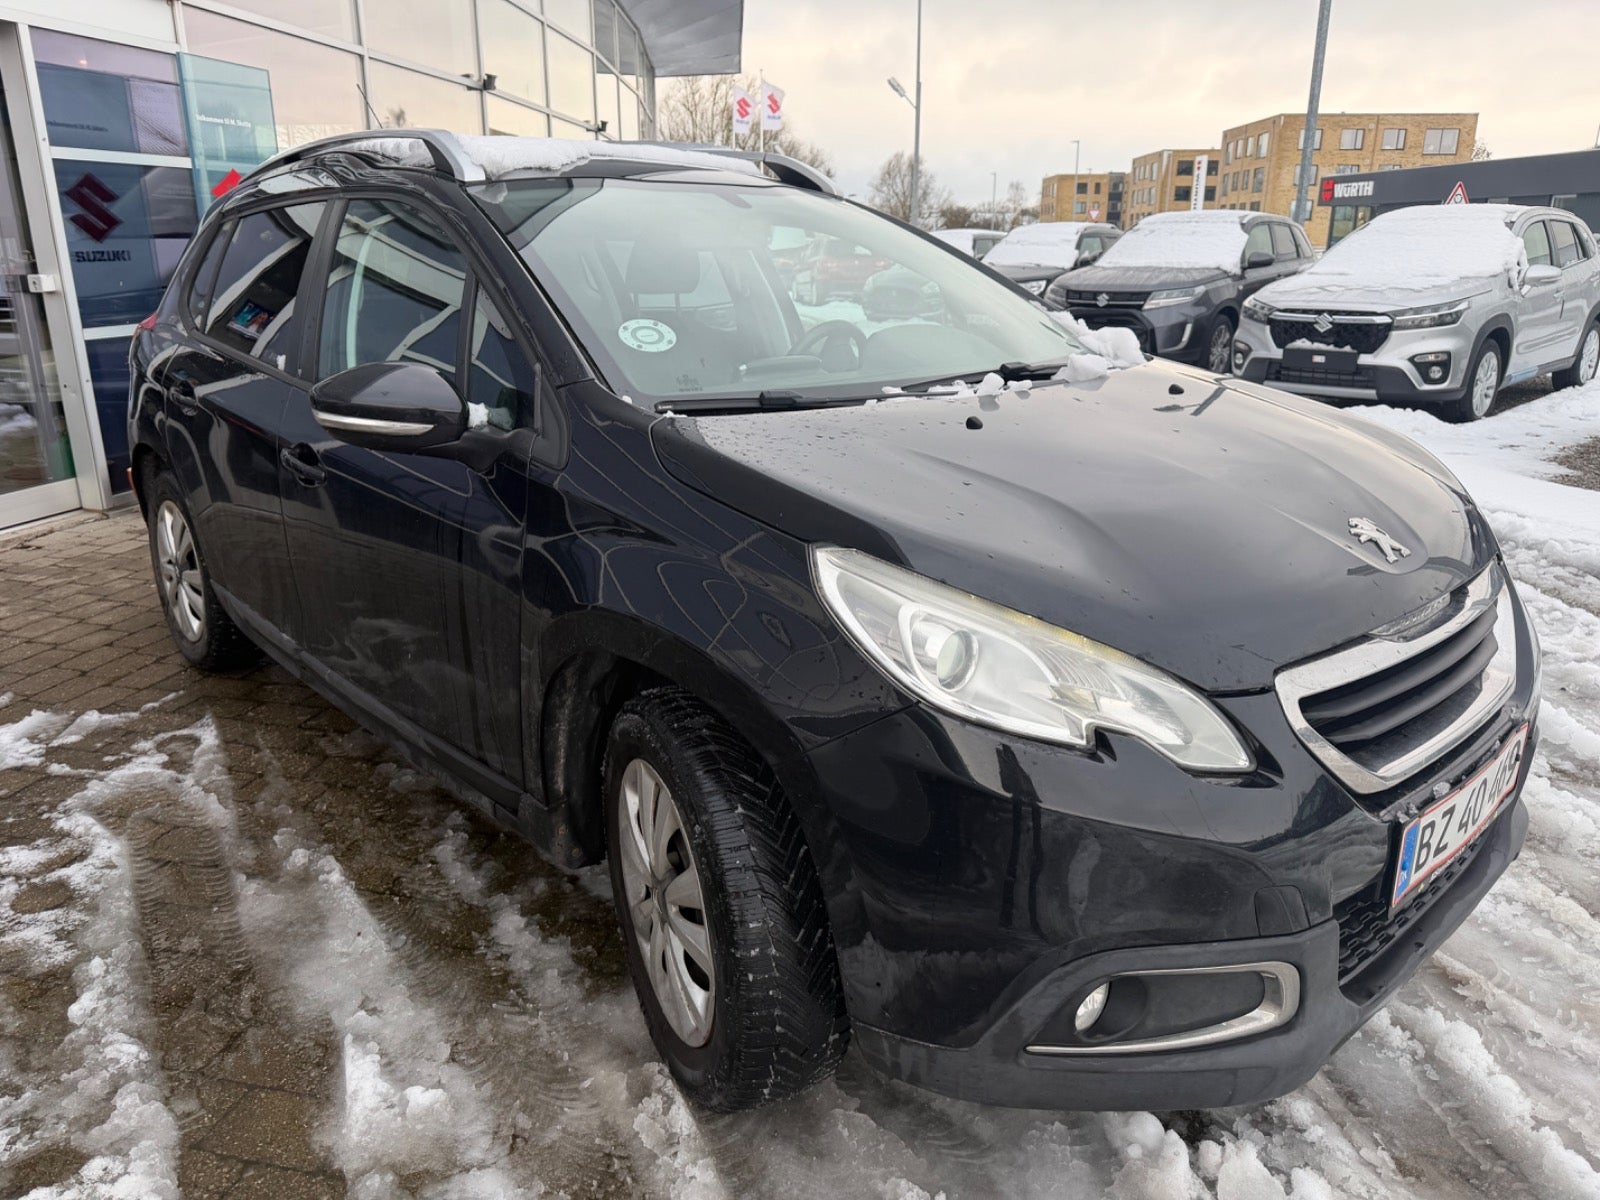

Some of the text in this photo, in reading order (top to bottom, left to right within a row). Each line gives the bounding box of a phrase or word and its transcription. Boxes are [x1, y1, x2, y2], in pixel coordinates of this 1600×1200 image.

[75, 250, 132, 262] SUZUKI
[1413, 739, 1521, 874] BZ 40 469
